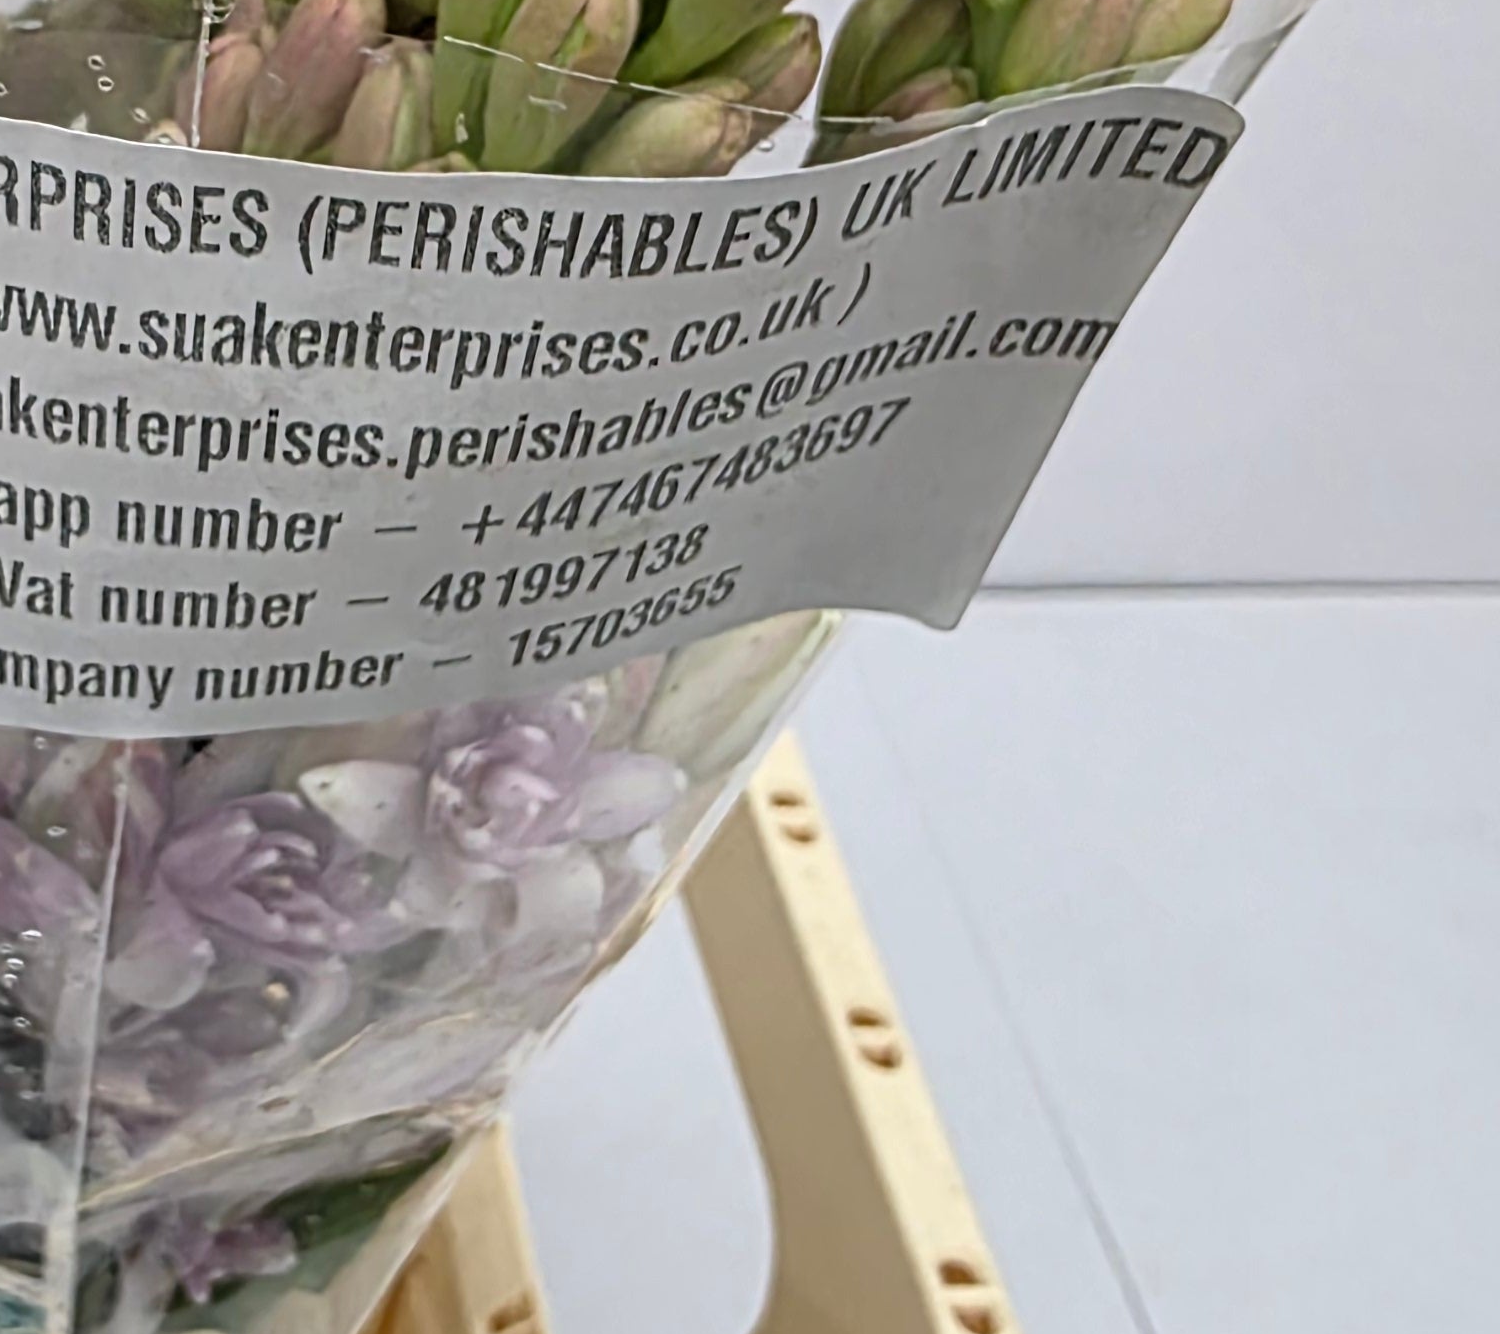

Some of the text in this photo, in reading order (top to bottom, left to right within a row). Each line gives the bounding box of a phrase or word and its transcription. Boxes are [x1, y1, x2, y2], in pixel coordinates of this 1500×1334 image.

[297, 194, 819, 280] (PERISHABLES)
[841, 159, 936, 242] UK
[941, 116, 1229, 208] LIMITED
[100, 580, 318, 630] number
[419, 523, 710, 614] 481997138
[116, 497, 344, 554] number
[194, 649, 405, 702] number
[509, 565, 742, 667] 15703655
